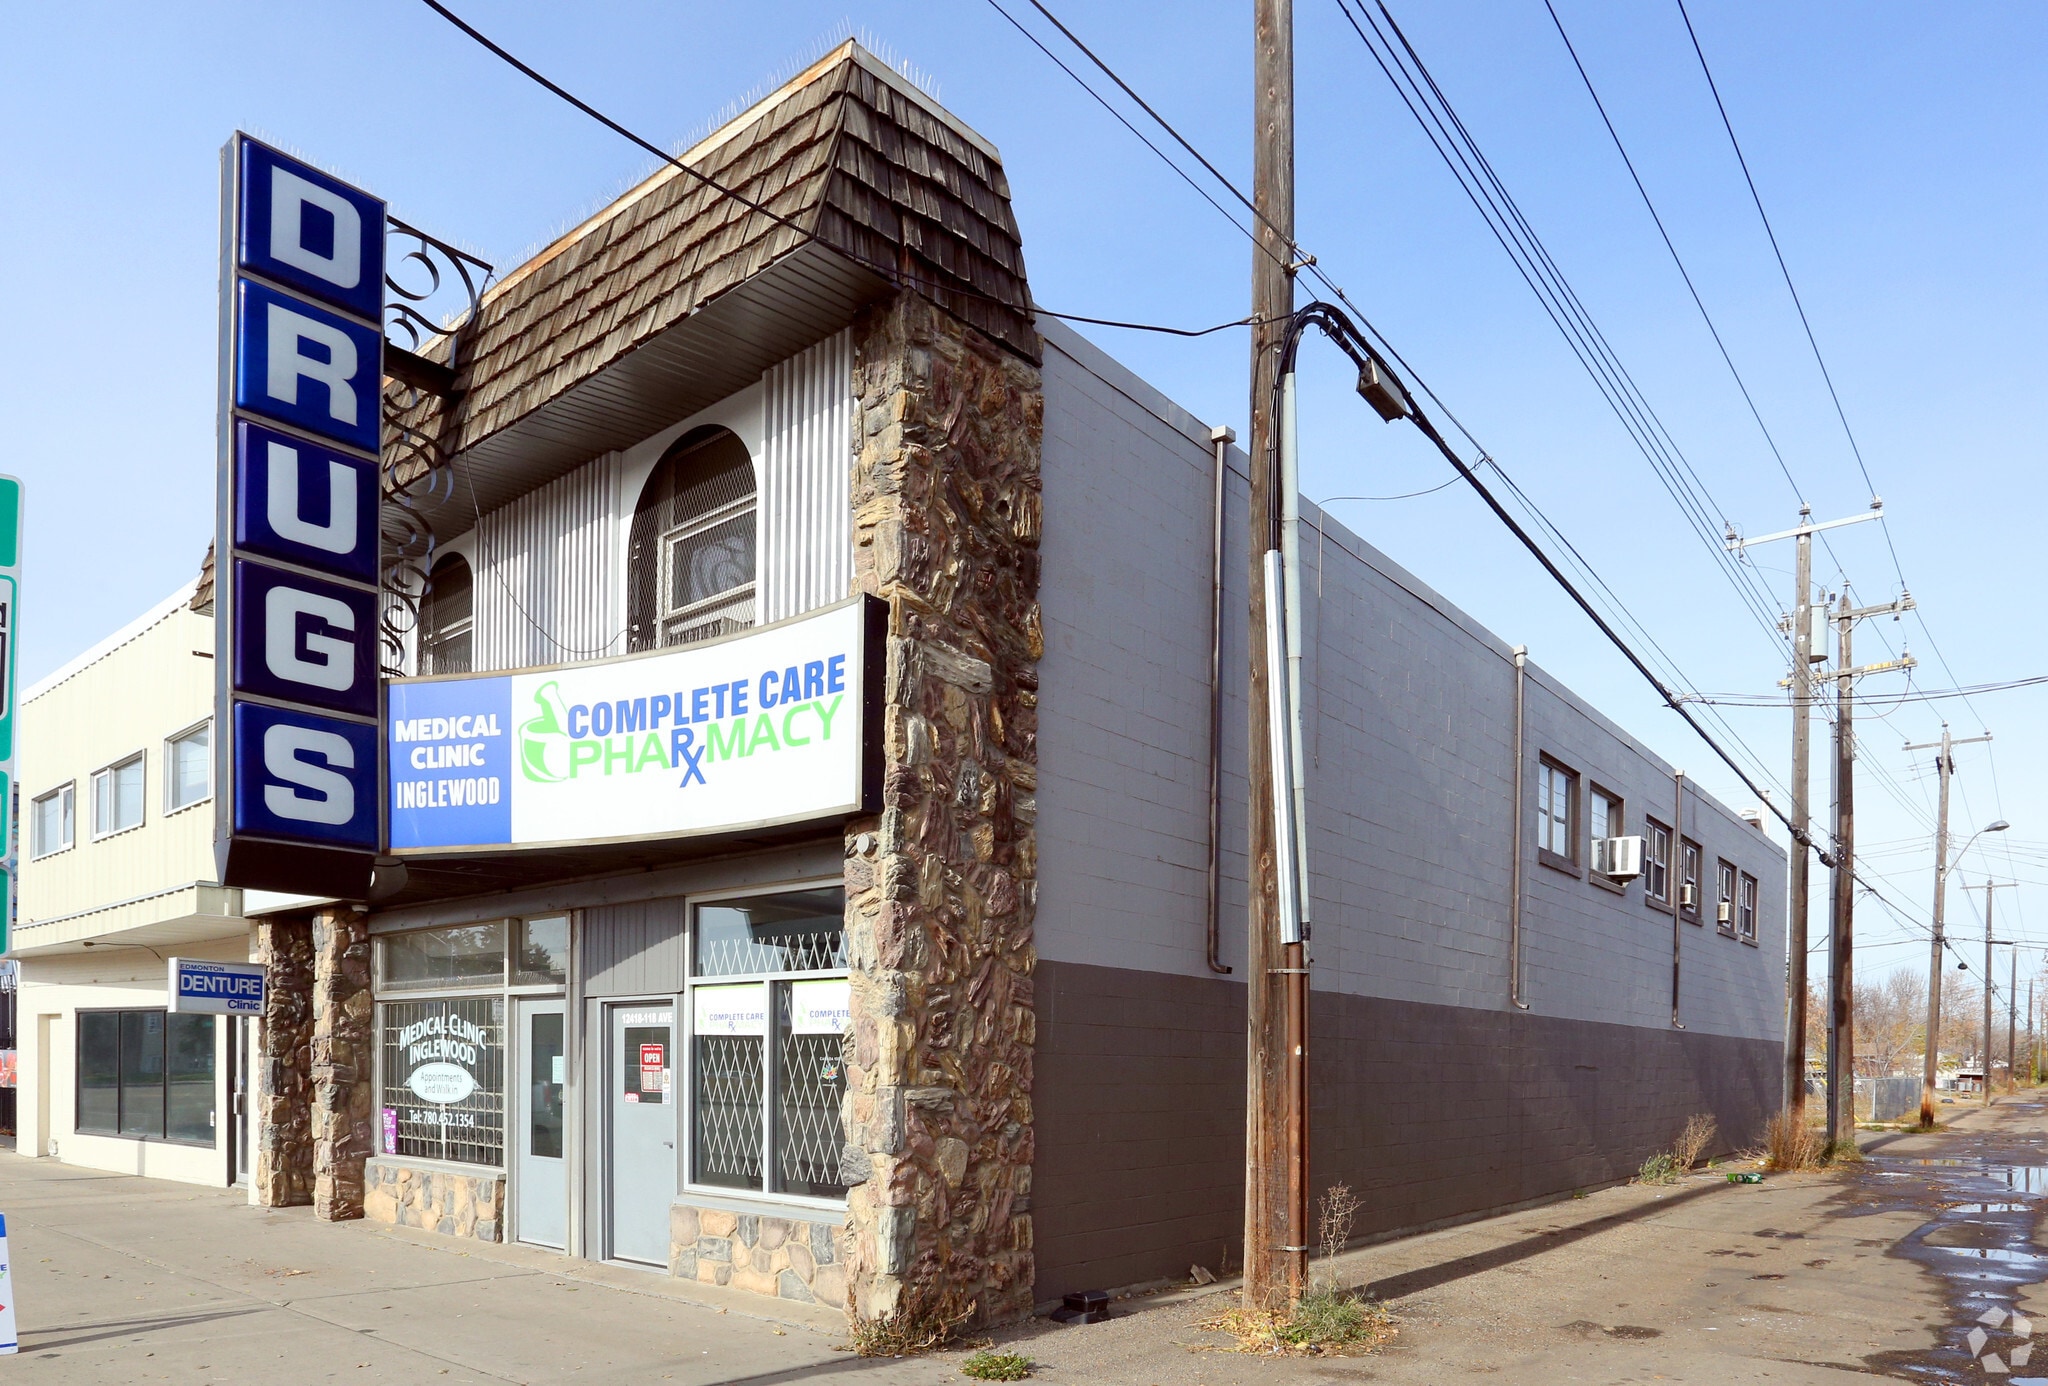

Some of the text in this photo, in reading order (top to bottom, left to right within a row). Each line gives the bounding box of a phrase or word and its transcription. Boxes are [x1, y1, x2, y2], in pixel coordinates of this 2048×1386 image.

[264, 164, 361, 825] DRUGS
[568, 653, 846, 740] COMPLETE CARE
[395, 713, 502, 742] MEDICAL
[410, 742, 486, 770] CLINIC
[396, 777, 500, 809] INGLEWOOD
[180, 963, 225, 973] EDMONTON
[180, 974, 261, 996] DENTURE
[227, 999, 260, 1011] Clinic
[657, 1012, 673, 1023] AVE
[709, 1012, 764, 1021] COMPLETE CARE
[809, 1010, 851, 1018] COMPLETE
[400, 1013, 487, 1052] MEDICAL CLINIC
[409, 1039, 477, 1066] INGLEWOOD
[644, 1053, 661, 1063] OPEN
[420, 1071, 463, 1085] Appointments
[424, 1083, 436, 1094] and
[409, 1110, 422, 1124] Tel:
